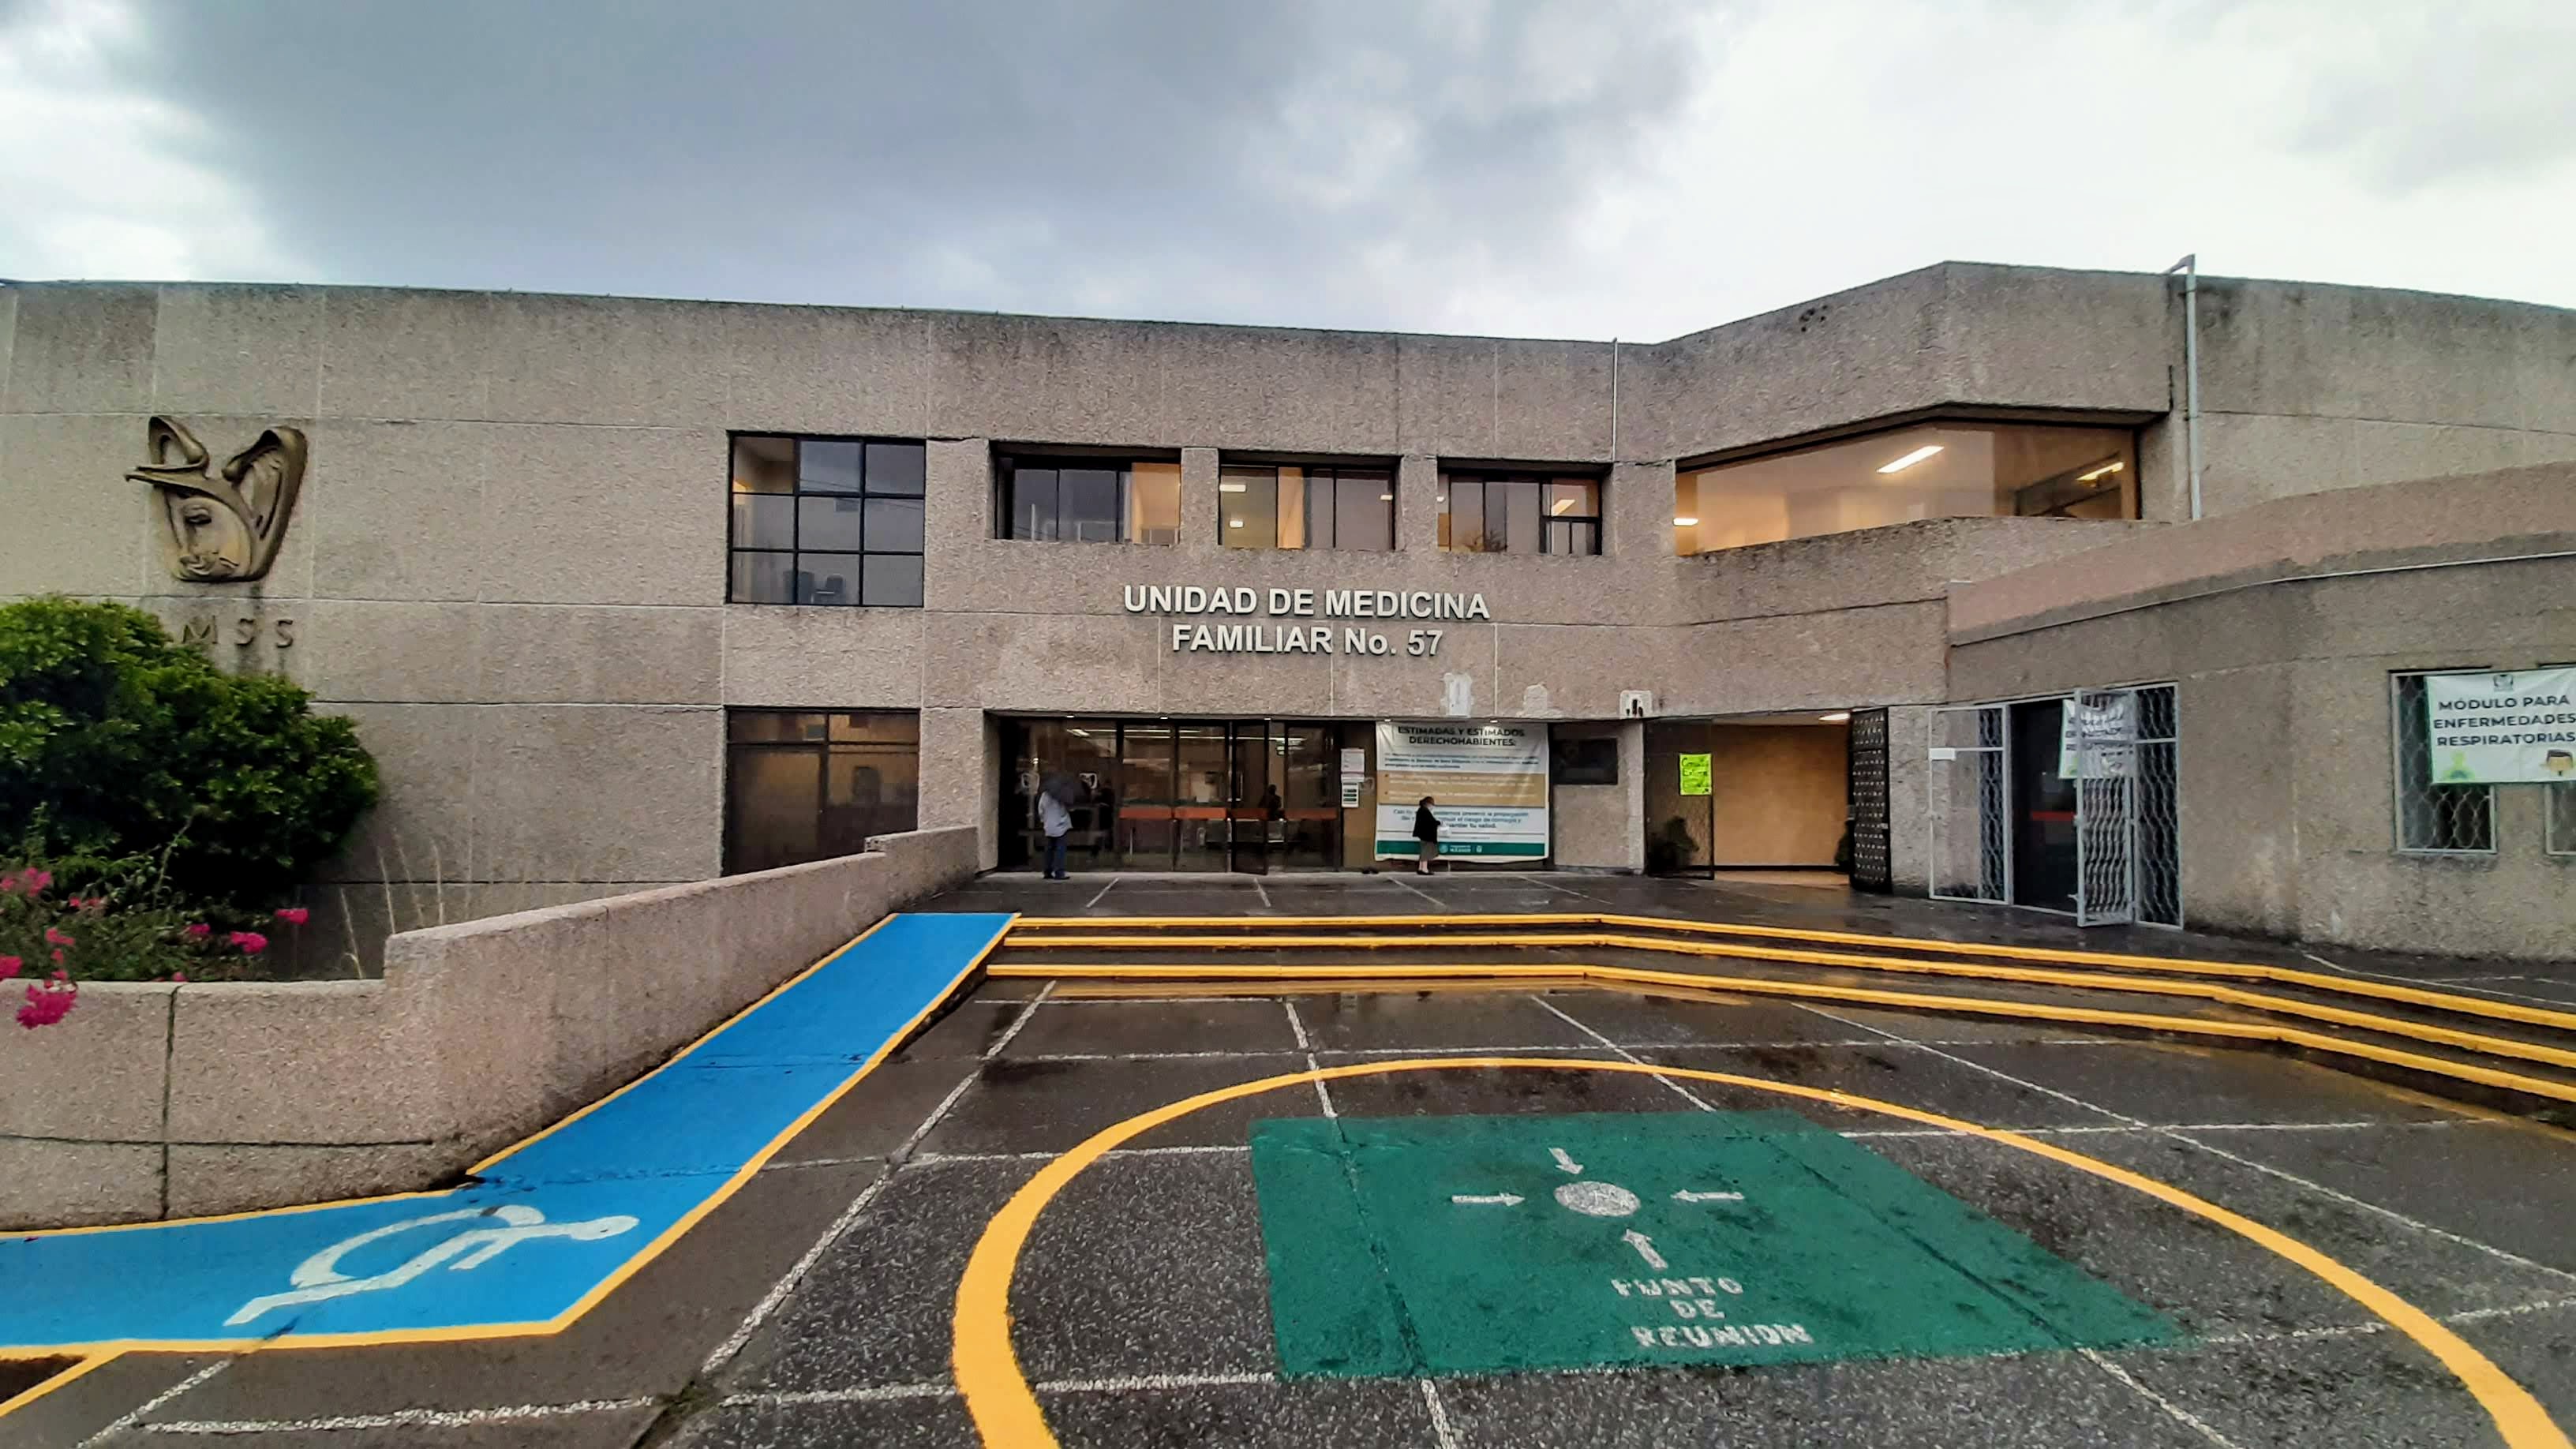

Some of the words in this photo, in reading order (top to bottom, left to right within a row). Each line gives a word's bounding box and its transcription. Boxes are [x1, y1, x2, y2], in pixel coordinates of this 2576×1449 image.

[1124, 584, 1258, 614] UNIDAD
[1268, 587, 1314, 616] DE
[1325, 589, 1491, 620] MEDICINA
[181, 615, 294, 649] MSS
[1173, 623, 1333, 653] FAMILIAR
[1344, 627, 1397, 656] No.
[1407, 629, 1443, 657] 57
[2439, 697, 2518, 710] MÓDULO
[2522, 695, 2570, 707] PARA
[2433, 713, 2576, 728] ENFERMEDADES
[1398, 726, 1455, 735] ESTIMADAS
[1467, 728, 1525, 736] ESTIMADOS
[2436, 732, 2576, 747] RESPIRATORIAS
[1611, 1277, 1743, 1297] PUNTO
[1669, 1299, 1726, 1319] DE
[1630, 1323, 1814, 1348] REUNION
